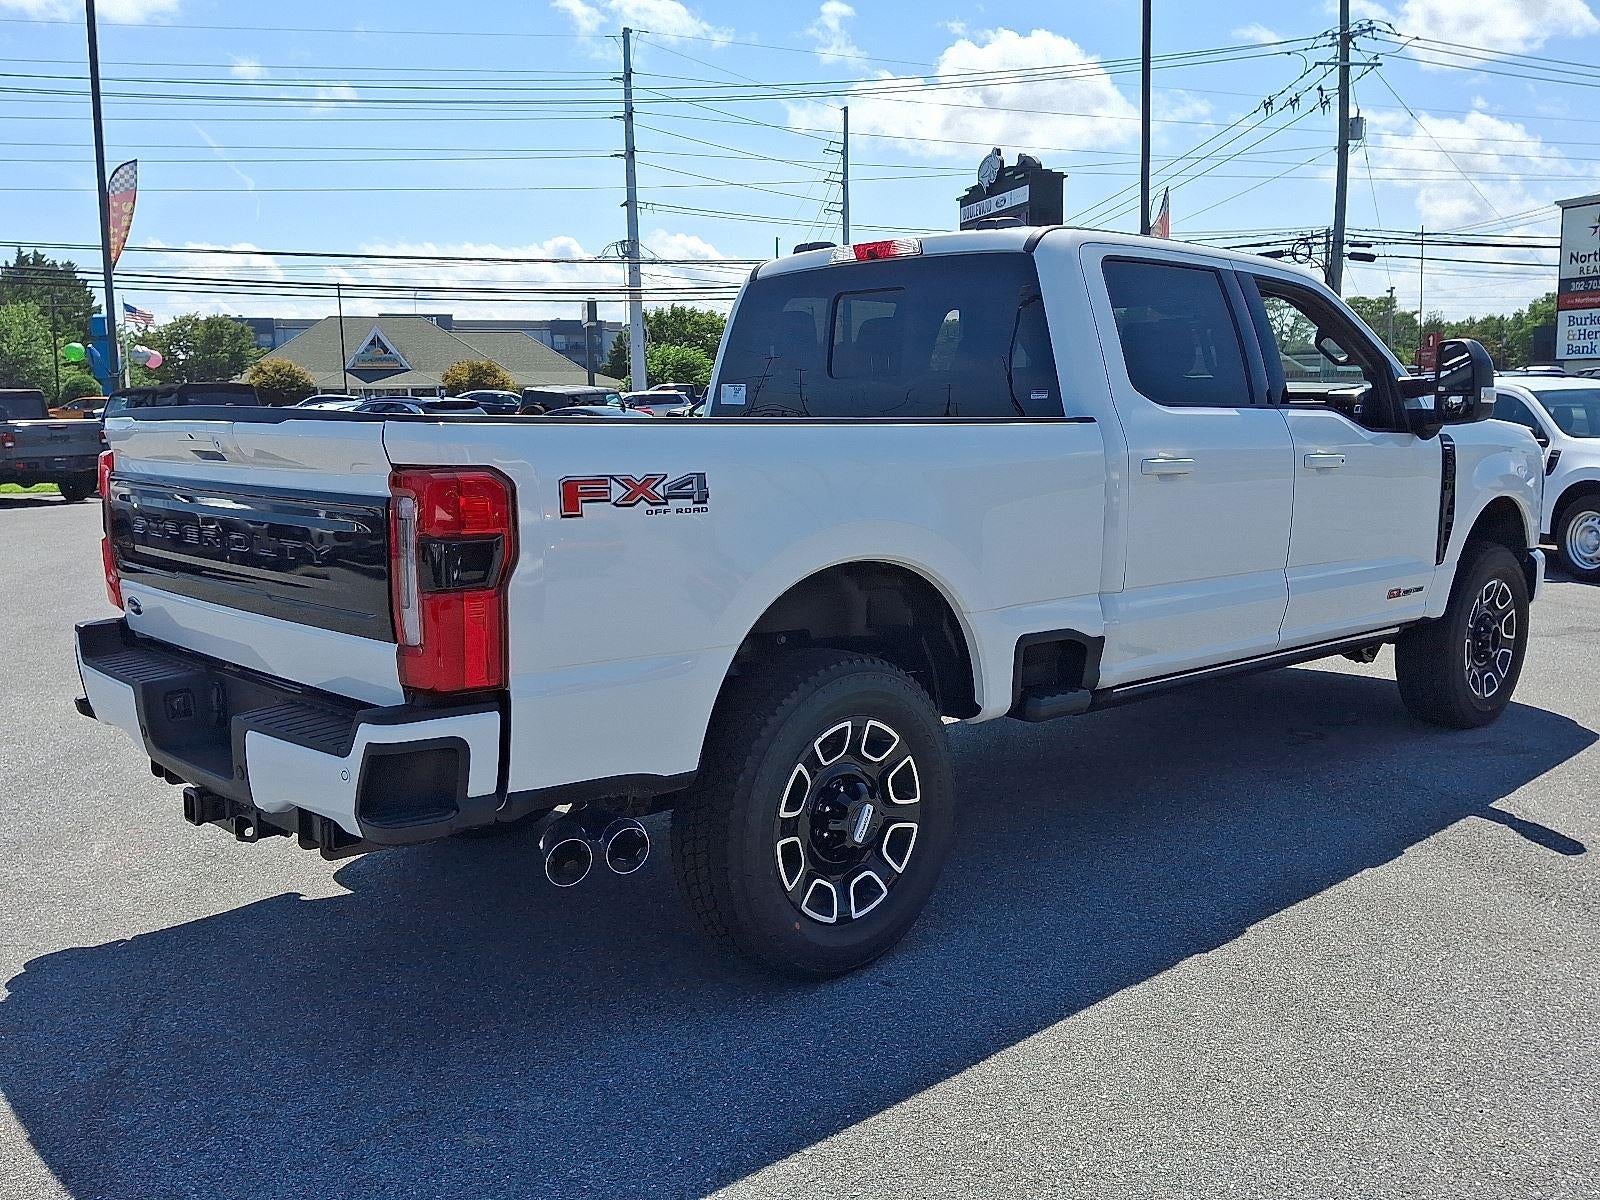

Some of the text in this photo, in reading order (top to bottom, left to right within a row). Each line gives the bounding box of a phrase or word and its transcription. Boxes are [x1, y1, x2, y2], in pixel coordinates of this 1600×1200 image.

[1569, 249, 1600, 264] Nort
[1579, 265, 1600, 275] REA
[1566, 341, 1597, 355] Bank
[559, 472, 709, 518] FX4
[675, 506, 709, 514] ROAD
